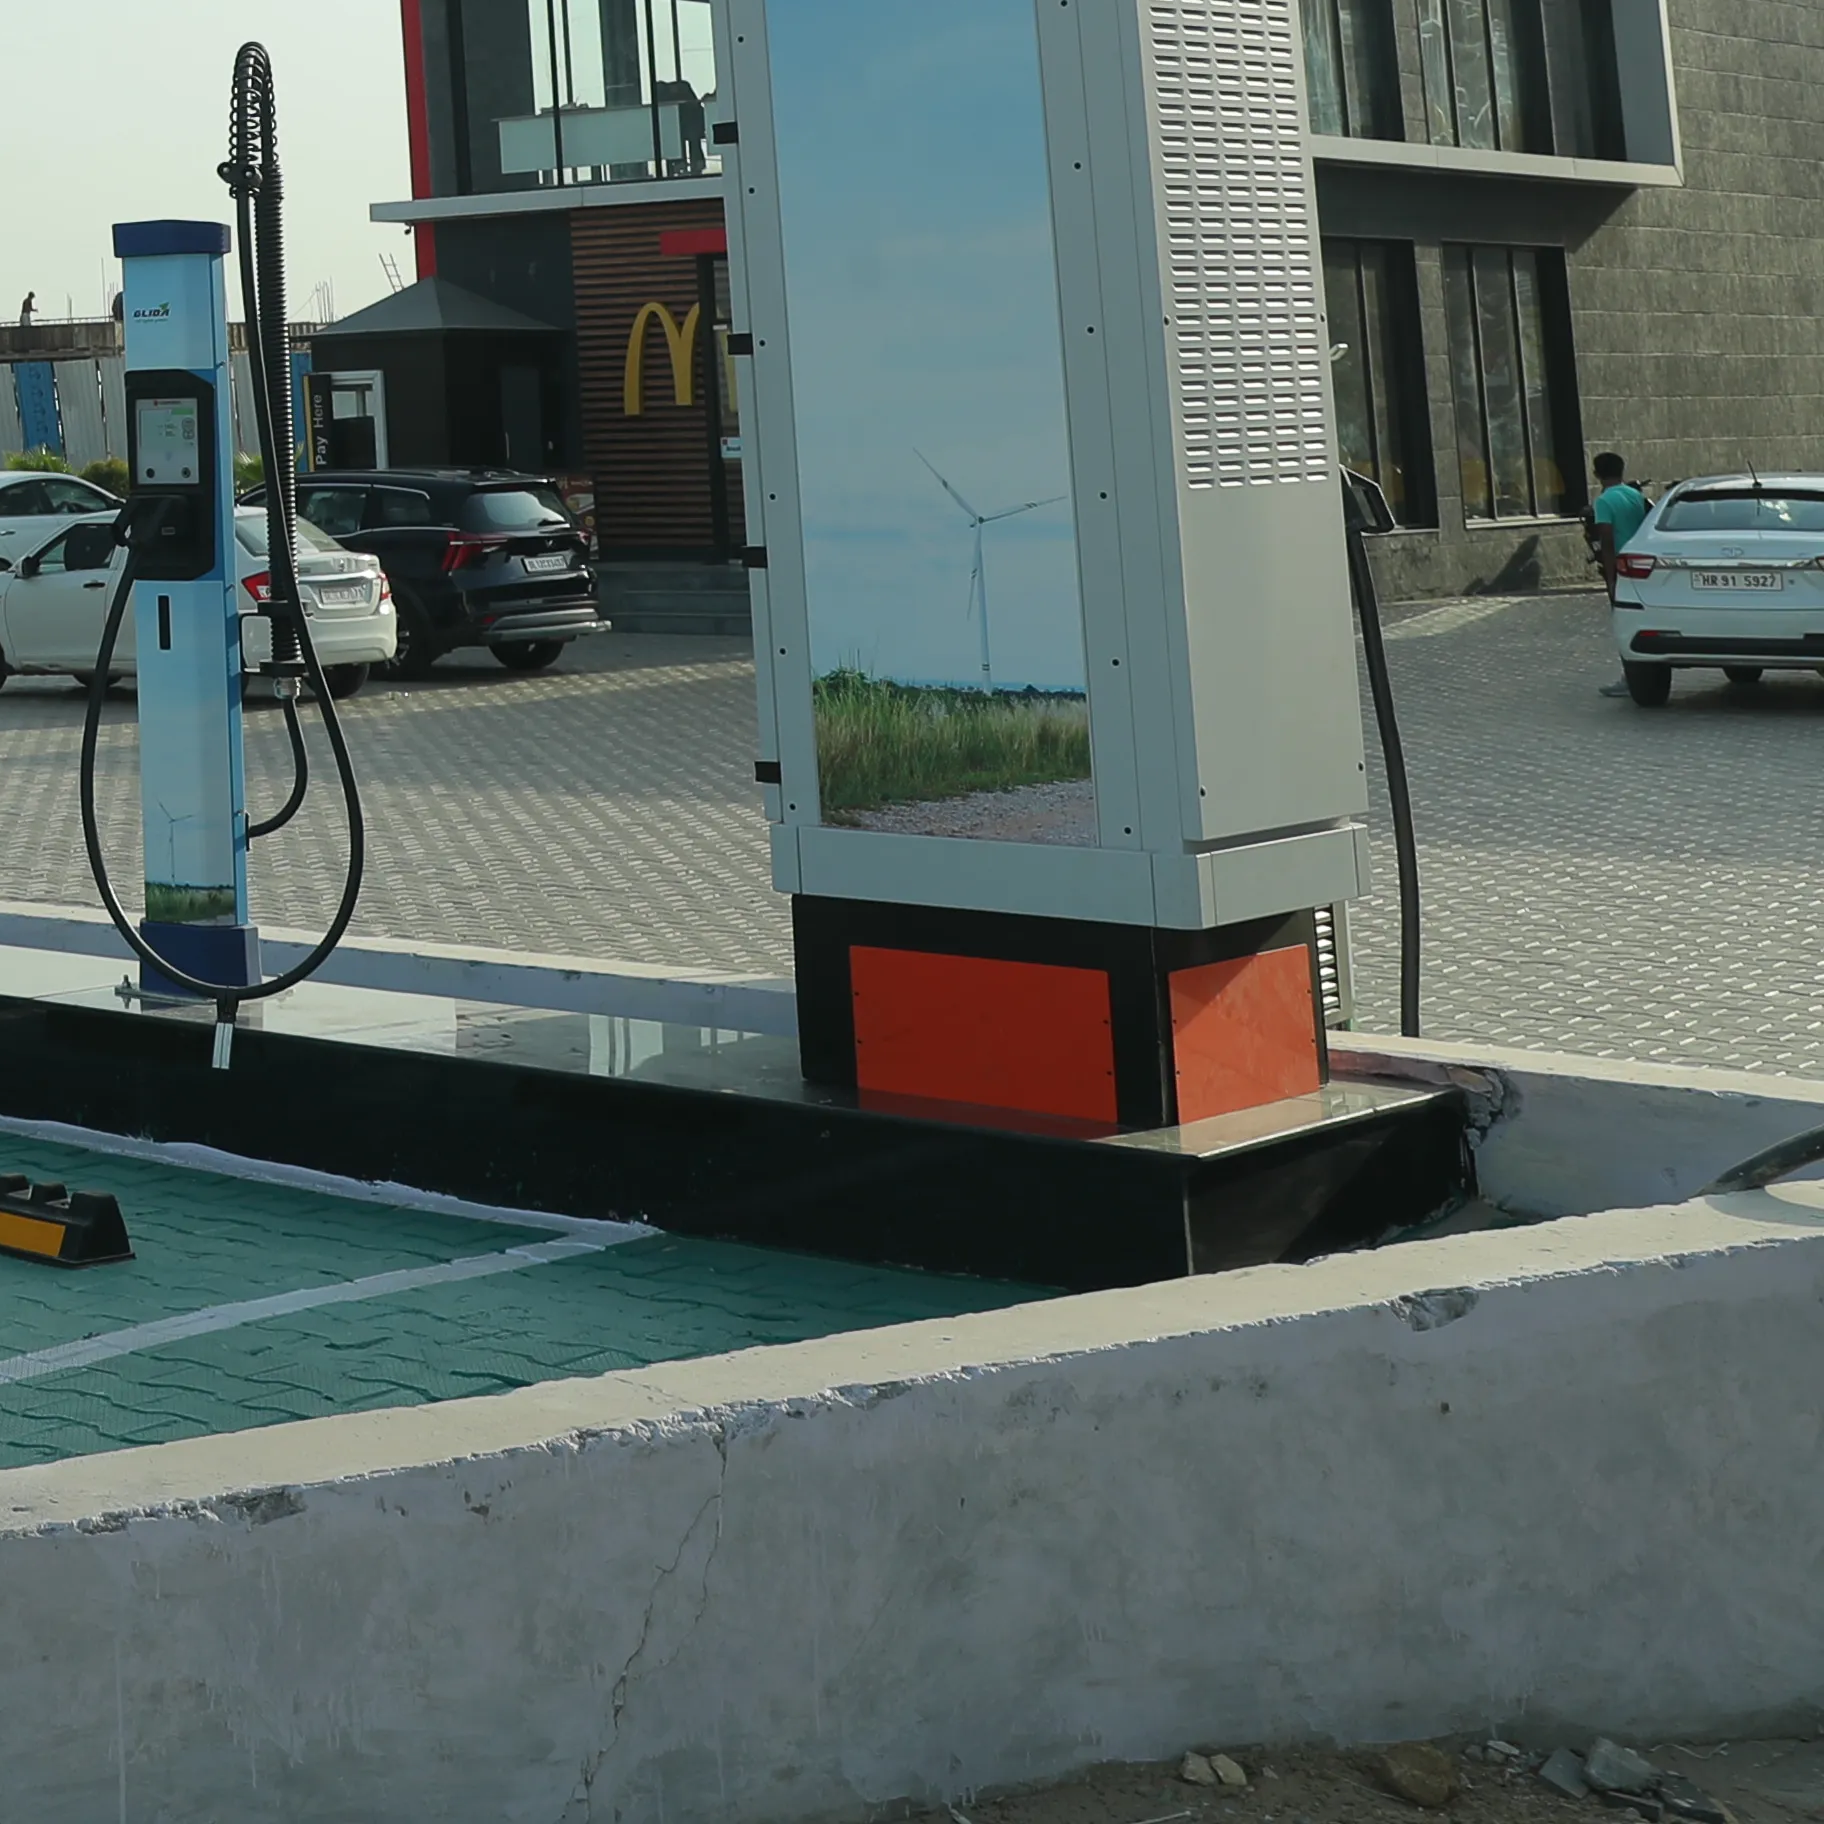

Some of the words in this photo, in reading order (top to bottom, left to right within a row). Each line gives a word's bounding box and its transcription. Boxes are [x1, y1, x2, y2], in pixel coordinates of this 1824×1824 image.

[312, 394, 324, 428] Here
[315, 435, 329, 466] Pay
[1702, 576, 1718, 587] HR
[1721, 576, 1737, 587] 91
